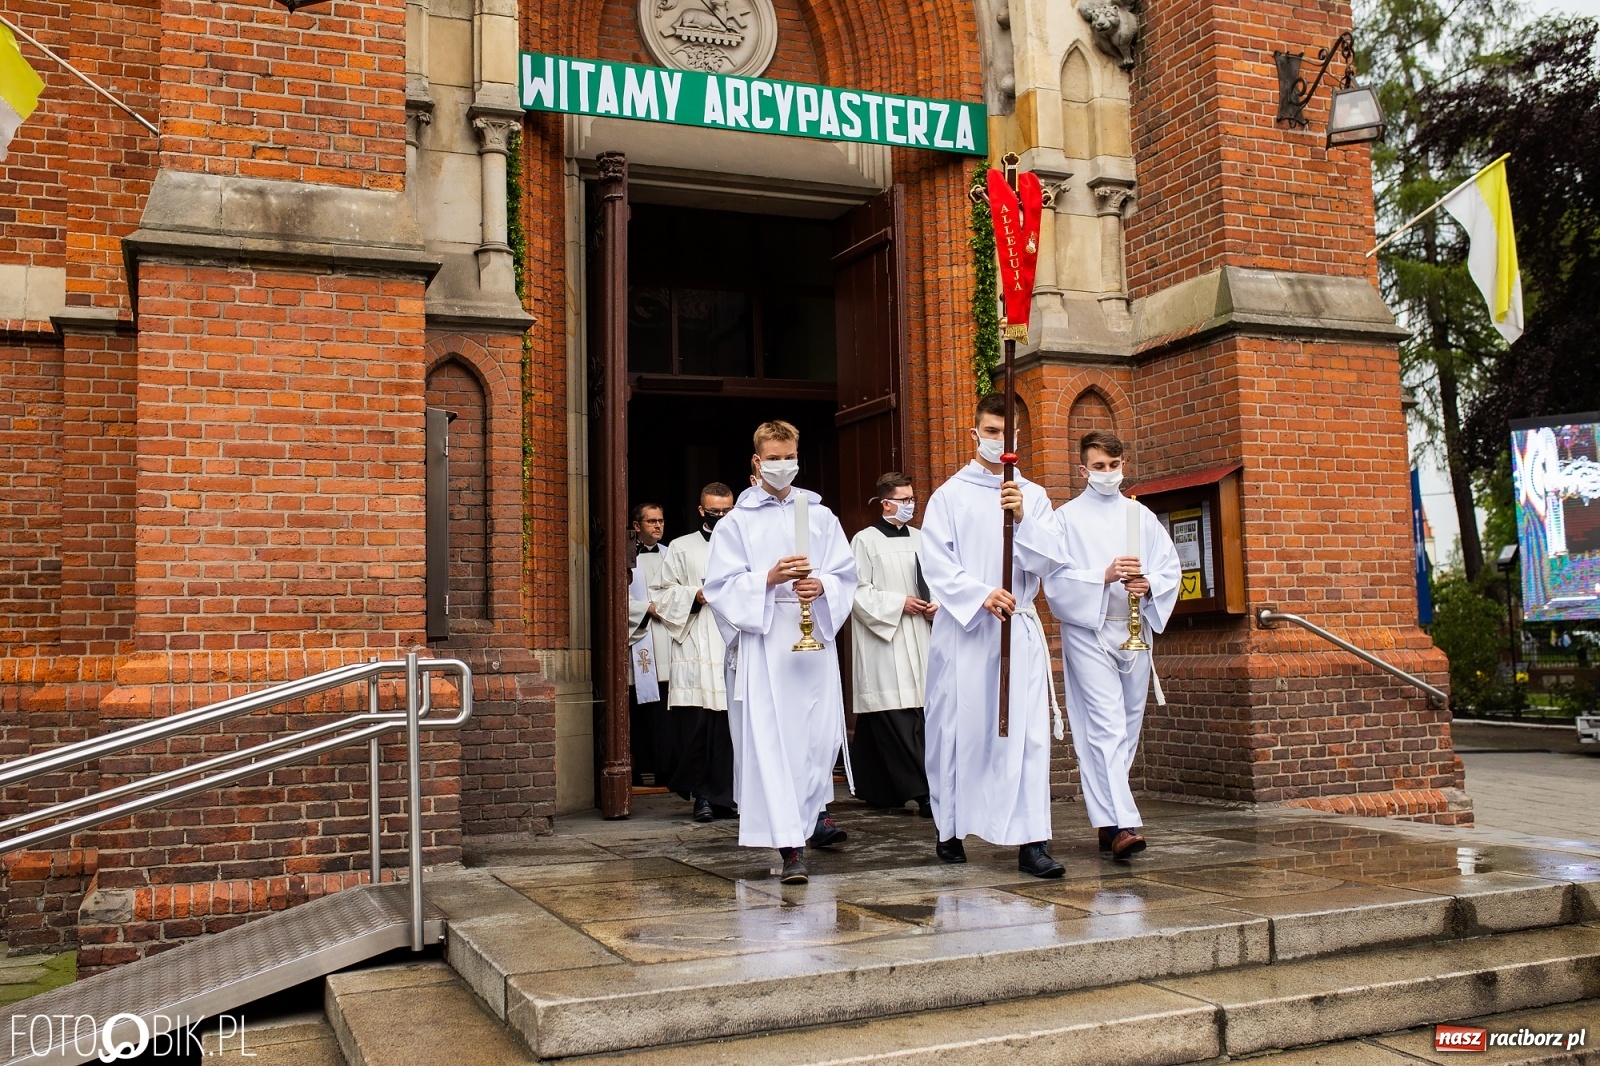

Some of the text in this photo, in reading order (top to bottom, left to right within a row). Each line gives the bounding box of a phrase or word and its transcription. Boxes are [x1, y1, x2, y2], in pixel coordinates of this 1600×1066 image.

[522, 54, 975, 151] WITAMY ARCYPASTERZA
[1000, 204, 1023, 291] ALLELUJA
